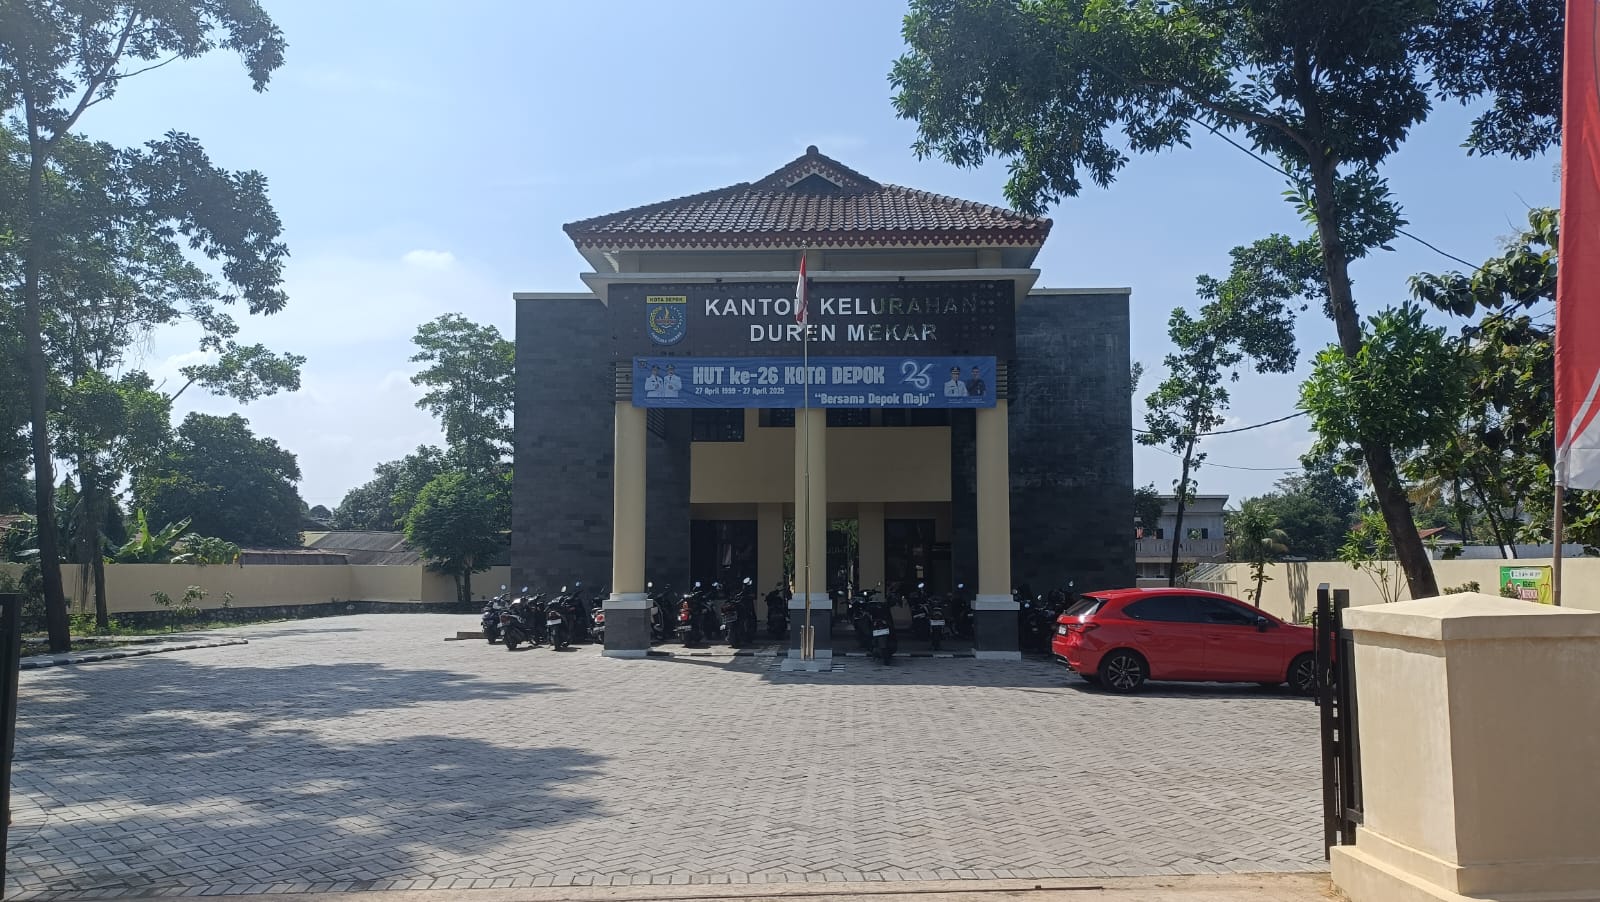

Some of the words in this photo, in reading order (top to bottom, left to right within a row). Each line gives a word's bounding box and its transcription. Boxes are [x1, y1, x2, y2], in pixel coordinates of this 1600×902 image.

[820, 297, 977, 315] KELURAHAN
[750, 324, 836, 341] DUREN
[847, 324, 937, 341] MEKAR
[692, 366, 725, 385] HUT
[729, 366, 779, 385] ke-26
[784, 366, 826, 385] KOTA
[831, 366, 885, 385] DEPOK
[695, 387, 703, 395] 27
[705, 387, 720, 396] April
[722, 387, 736, 395] 1999
[743, 387, 751, 395] 27
[752, 387, 767, 396] April
[769, 387, 785, 395] 2025
[868, 393, 899, 406] Depok
